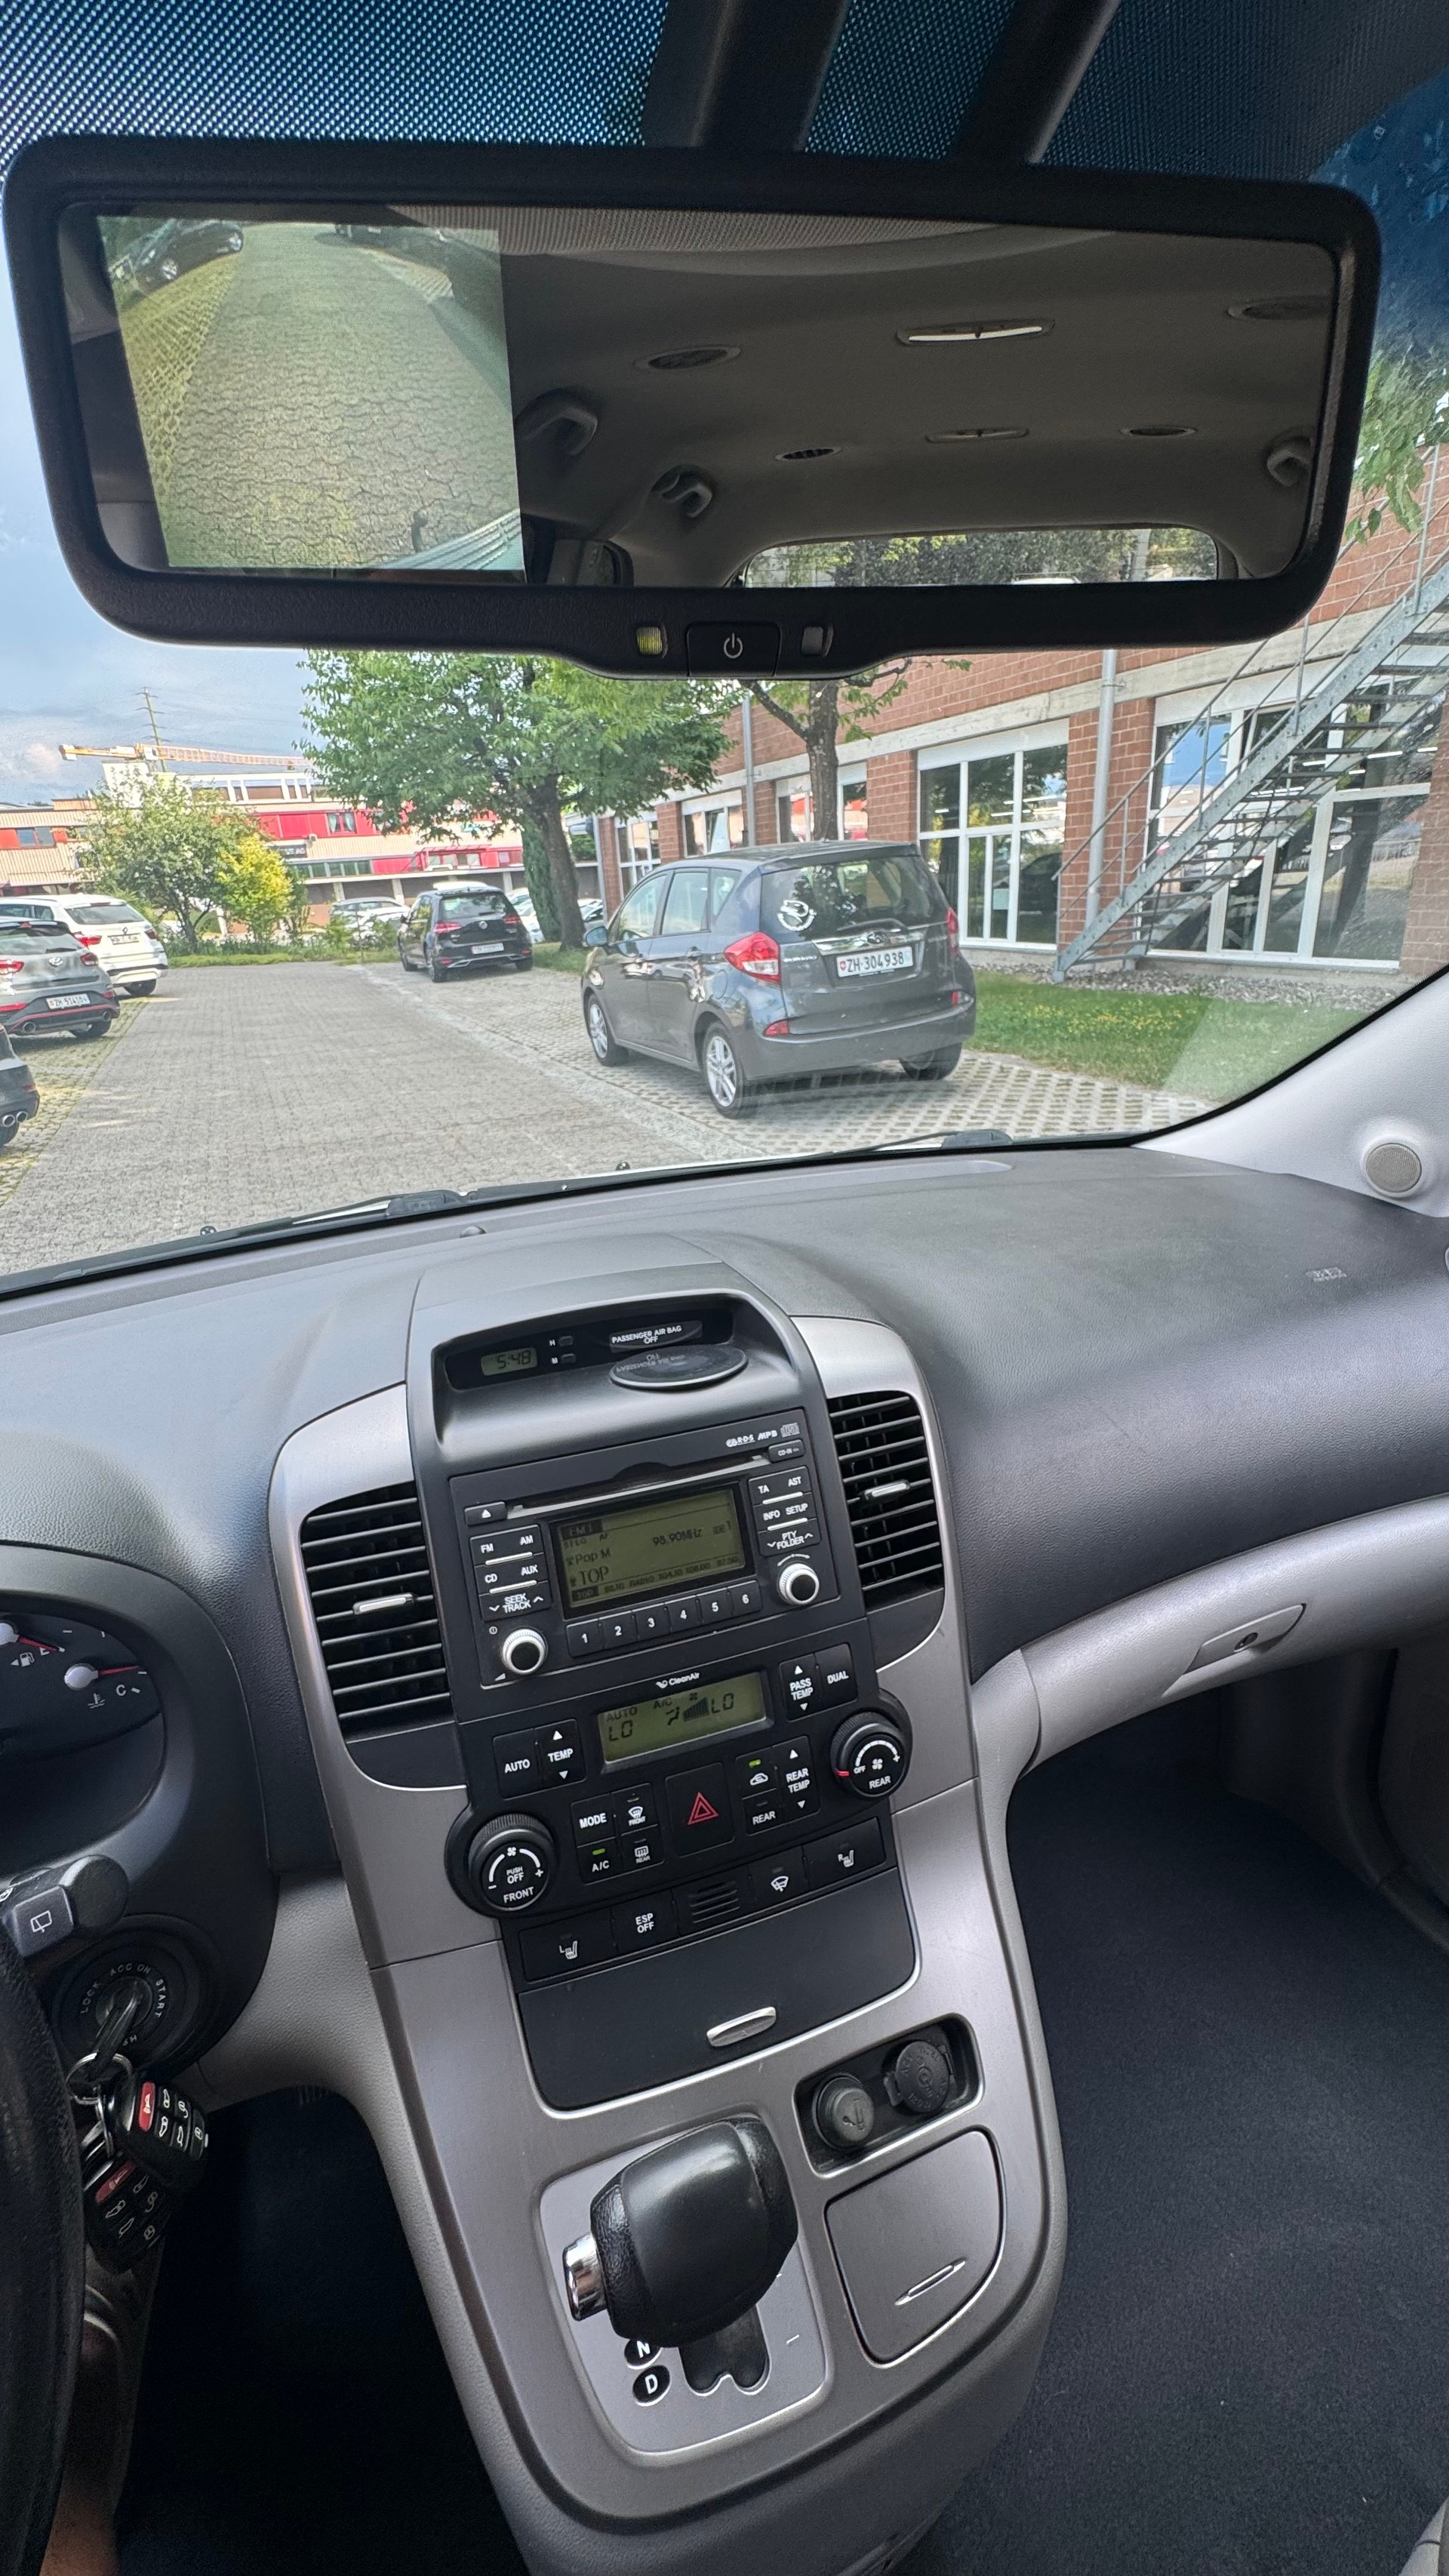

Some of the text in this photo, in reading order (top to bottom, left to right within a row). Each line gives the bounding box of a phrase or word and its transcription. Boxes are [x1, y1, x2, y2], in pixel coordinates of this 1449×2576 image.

[611, 1325, 682, 1344] PASSENGER AIR BAG
[644, 1335, 658, 1344] OFF
[497, 1351, 531, 1370] 5:48
[758, 1476, 801, 1494] TA AST
[763, 1503, 808, 1521] INFO SETUP
[782, 1531, 797, 1540] PTY
[480, 1534, 534, 1553] FM AM
[777, 1536, 804, 1550] FOLDER
[485, 1565, 538, 1583] CD AUX
[580, 1566, 609, 1585] TOP
[504, 1593, 527, 1605] SEEK
[503, 1599, 531, 1614] TRACK
[582, 1594, 749, 1643] 1 2 3 4 5 6
[669, 1672, 700, 1685] CleanAir
[789, 1677, 812, 1691] PASS
[827, 1670, 849, 1685] DUAL
[115, 1684, 127, 1696] C
[791, 1687, 814, 1700] TEMP
[606, 1697, 673, 1722] AUTO A/C
[547, 1748, 574, 1762] TEMP
[504, 1759, 531, 1774] AUTO
[854, 1765, 866, 1774] OFF
[786, 1768, 809, 1783] REAR
[869, 1775, 891, 1789] REAR
[788, 1779, 811, 1793] TEMP
[579, 1813, 607, 1829] MODE
[628, 1816, 646, 1826] FRONT
[752, 1811, 776, 1825] REAR
[592, 1860, 610, 1873] A/C
[635, 1855, 651, 1864] REAR
[506, 1866, 523, 1876] PUSH
[507, 1872, 524, 1884] OFF
[503, 1886, 534, 1904] FRONT
[635, 1913, 654, 1925] ESP
[637, 1921, 654, 1933] OFF
[110, 1963, 132, 1976] ACC
[137, 1964, 151, 1974] ON
[80, 1980, 100, 2014] LOCK
[155, 1978, 166, 2017] START
[636, 2341, 651, 2359] N
[645, 2374, 658, 2394] D
